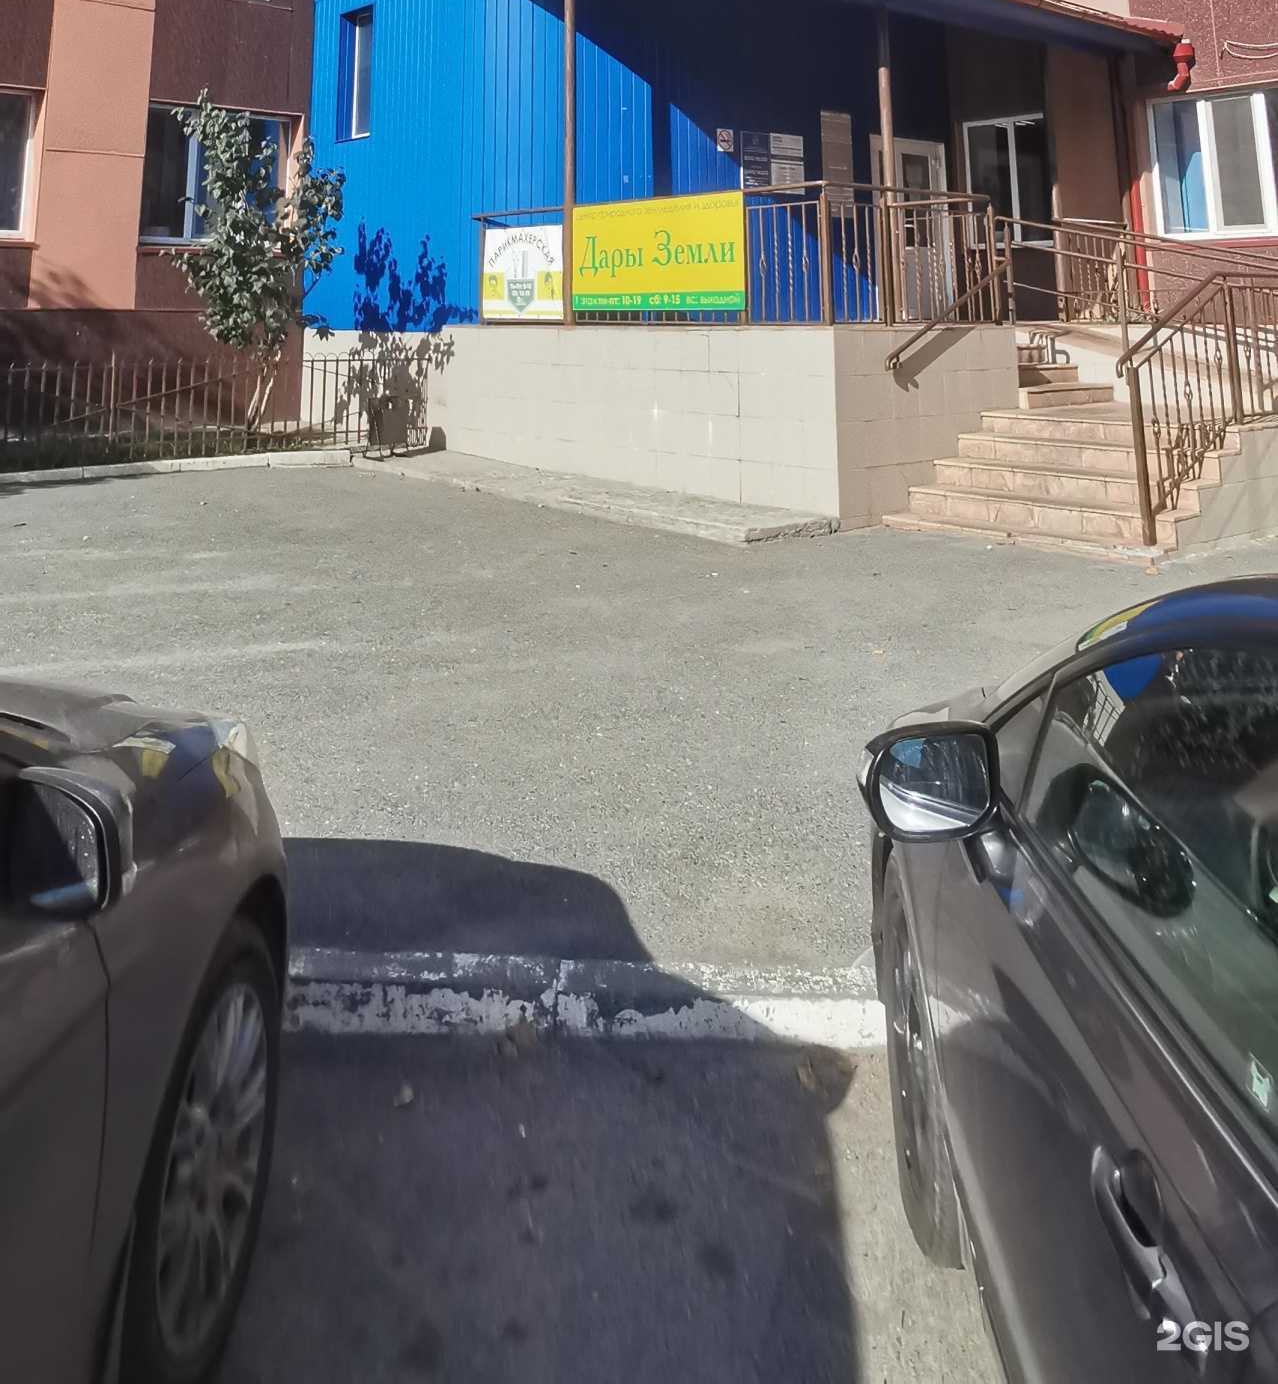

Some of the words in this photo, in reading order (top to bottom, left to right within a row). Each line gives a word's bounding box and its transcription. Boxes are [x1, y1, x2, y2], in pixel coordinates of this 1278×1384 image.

[488, 233, 556, 268] ПАРИКМАХЕРСКАЯ
[578, 235, 644, 278] Дары
[652, 230, 736, 267] Земли
[622, 295, 641, 305] 10-19
